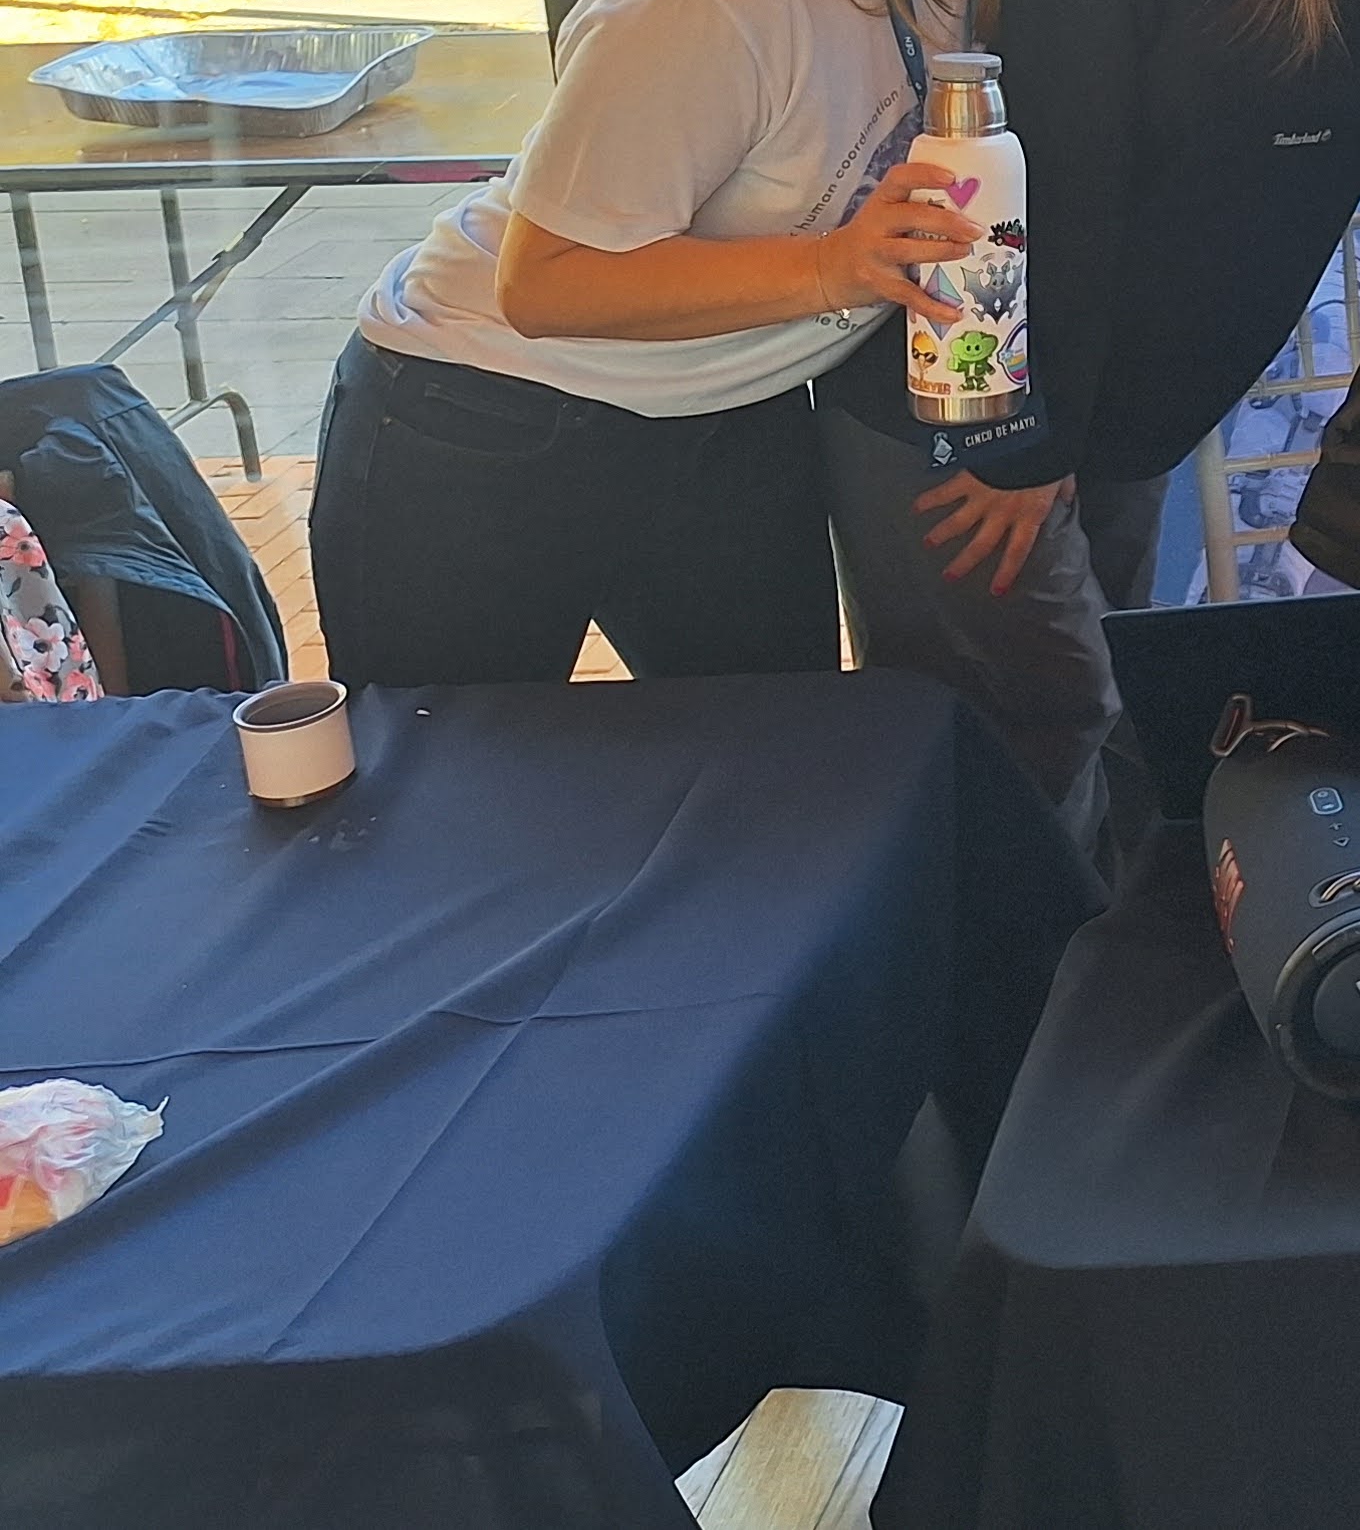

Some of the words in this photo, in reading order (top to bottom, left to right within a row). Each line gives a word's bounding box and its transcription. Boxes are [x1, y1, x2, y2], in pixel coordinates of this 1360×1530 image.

[1273, 130, 1322, 146] Timberland
[795, 183, 838, 230] human
[836, 89, 900, 180] coordination
[965, 430, 993, 448] CINCO
[996, 425, 1007, 438] DE
[1009, 416, 1036, 434] MAYO
